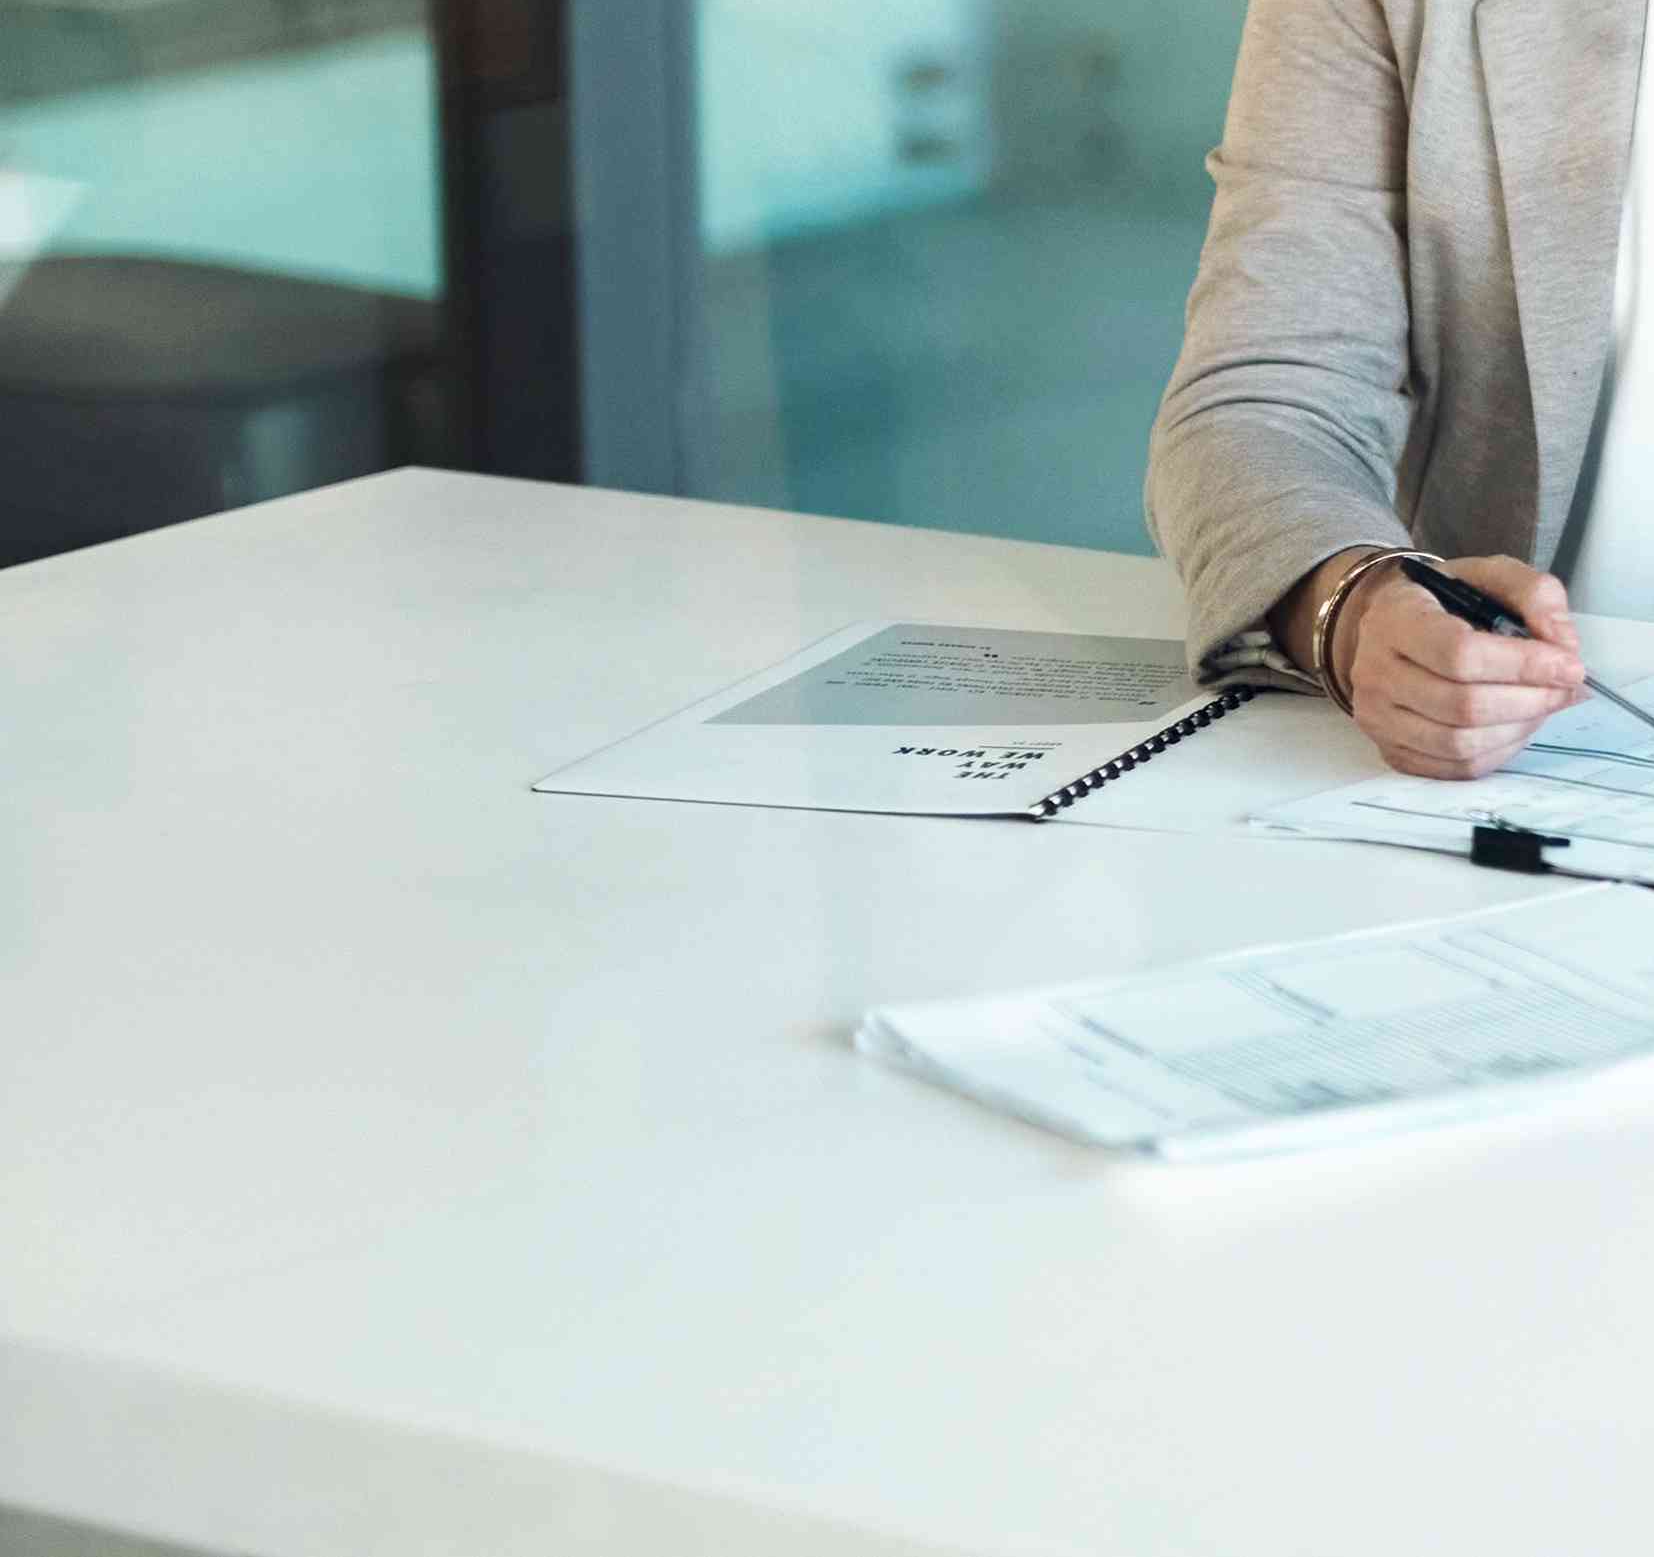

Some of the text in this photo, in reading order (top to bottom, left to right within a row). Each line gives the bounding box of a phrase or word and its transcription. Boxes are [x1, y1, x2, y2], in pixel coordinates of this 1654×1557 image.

[892, 746, 1045, 760] WE WORK
[956, 760, 1028, 770] WAY
[954, 771, 1010, 780] THE
